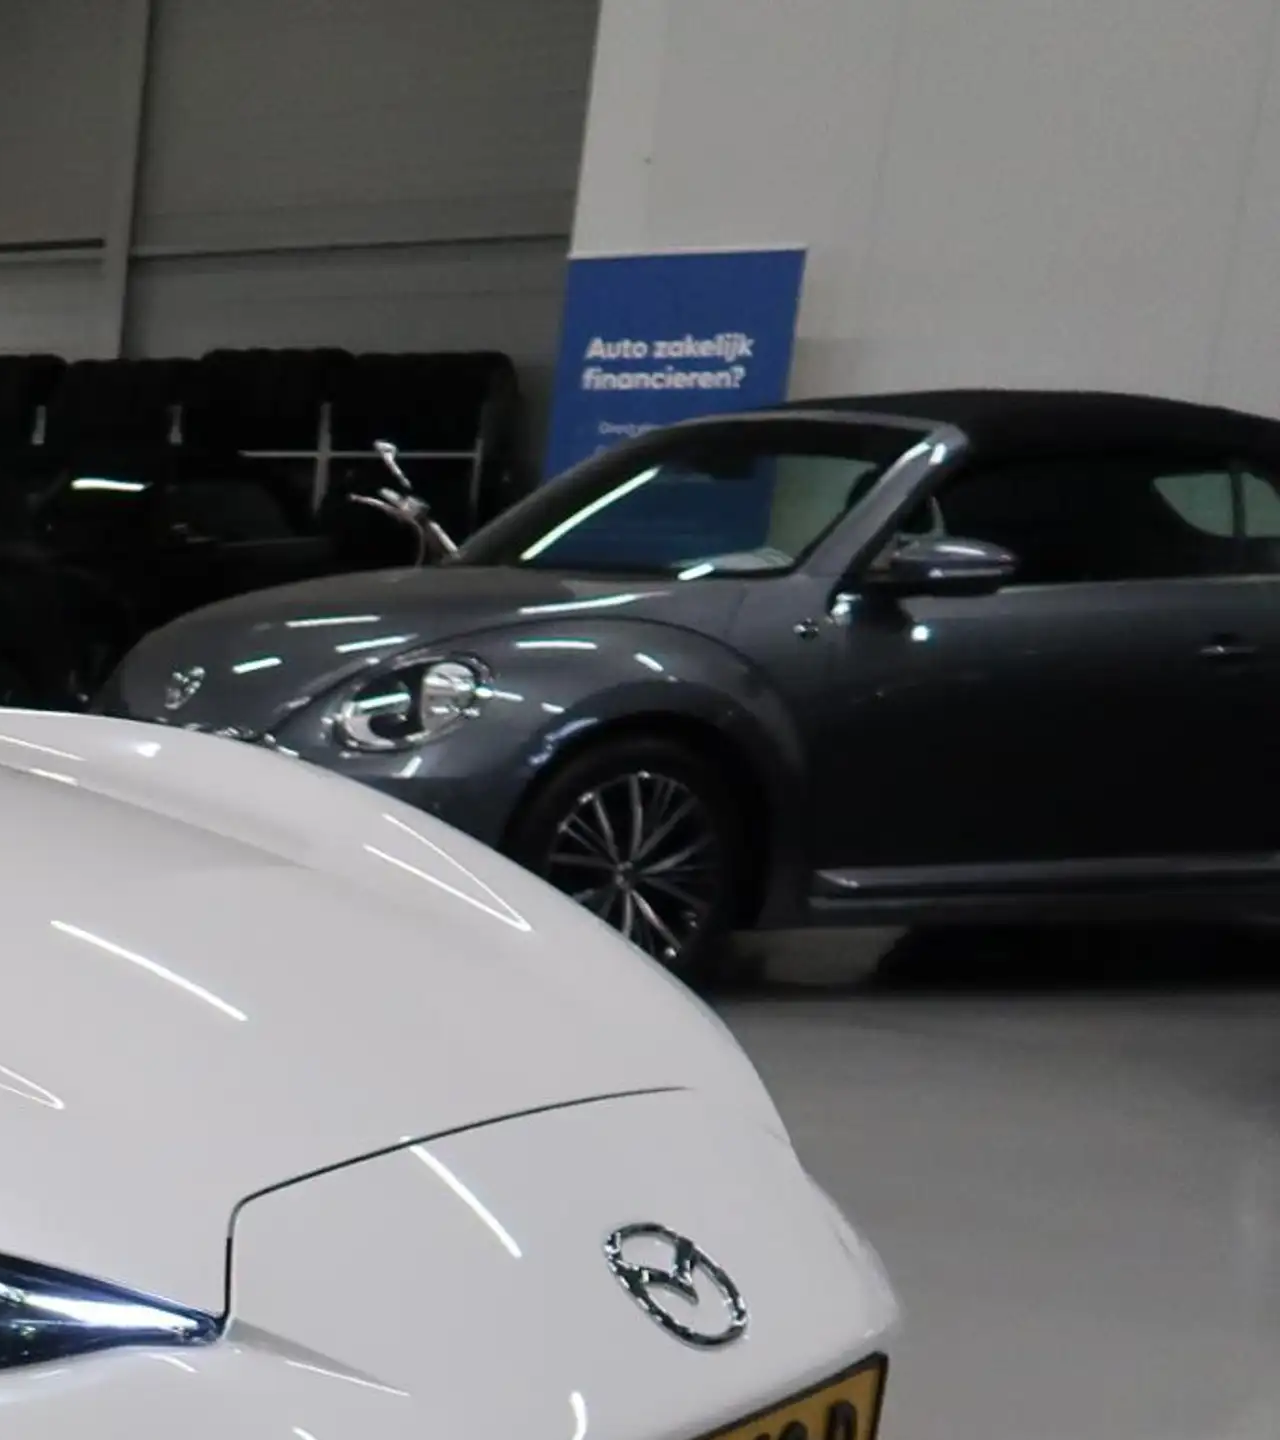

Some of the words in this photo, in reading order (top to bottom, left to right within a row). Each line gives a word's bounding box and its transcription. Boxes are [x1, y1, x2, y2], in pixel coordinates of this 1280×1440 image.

[585, 336, 648, 360] Auto
[653, 332, 754, 362] zakelijk
[581, 365, 746, 390] financieren?
